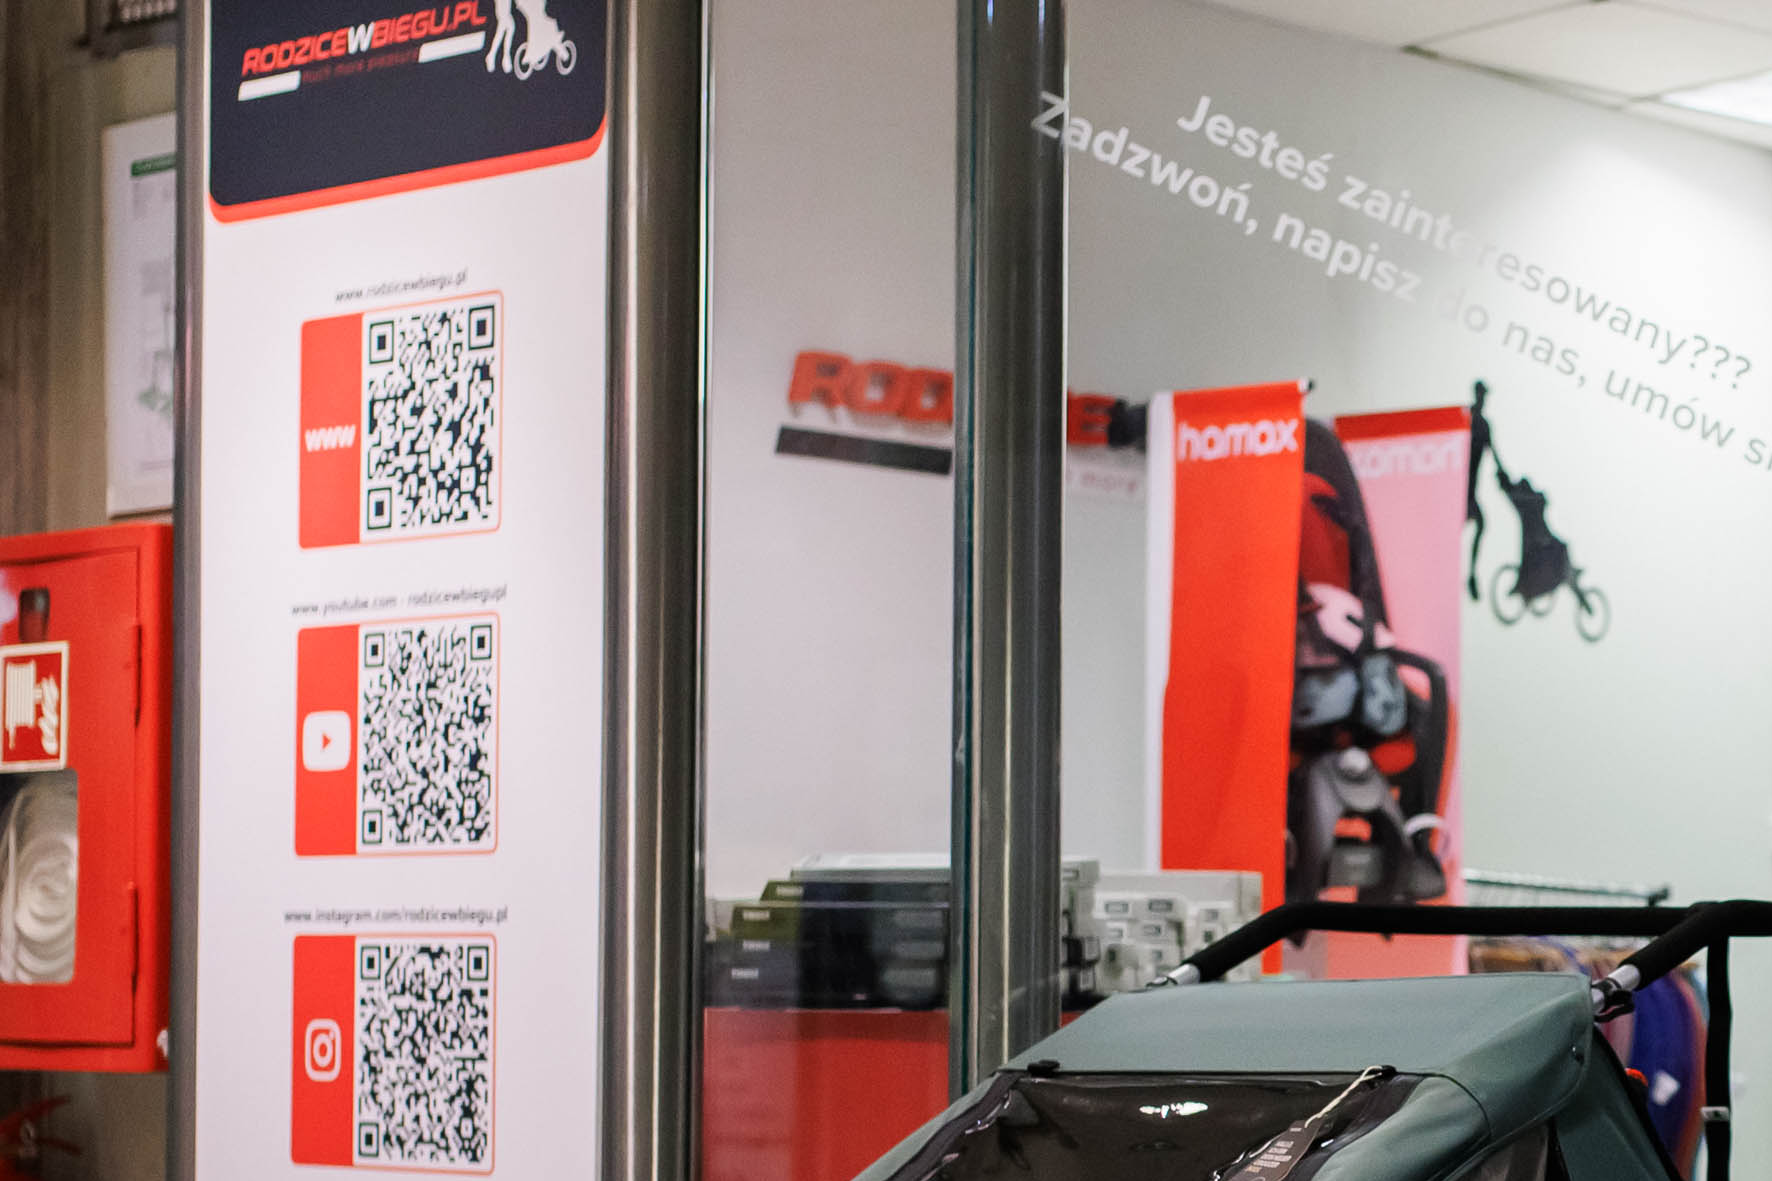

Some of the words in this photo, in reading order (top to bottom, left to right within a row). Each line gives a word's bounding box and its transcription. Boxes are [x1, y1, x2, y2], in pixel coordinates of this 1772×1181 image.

[241, 1, 487, 77] RODZICEWBIEGU.PL
[1031, 90, 1258, 236] Zadzwoń,
[1272, 213, 1422, 301] napisz
[1440, 287, 1490, 333] do
[1502, 320, 1586, 388] nas,
[1604, 369, 1735, 448] umów
[1176, 95, 1334, 192] Jesteś
[1338, 175, 1752, 390] zainteresowany???
